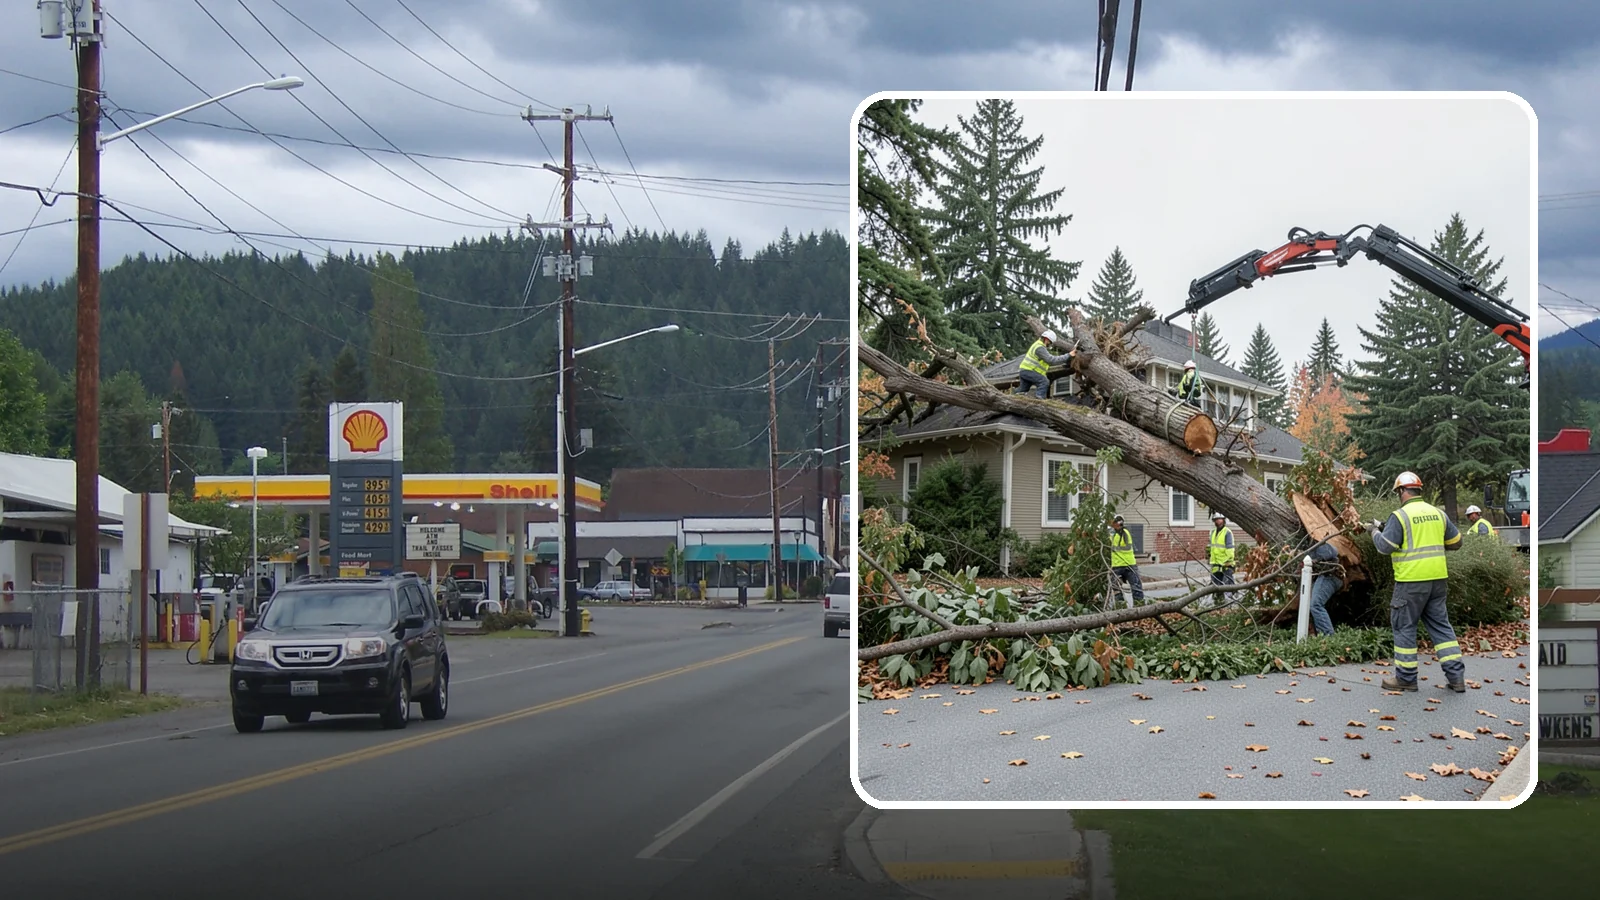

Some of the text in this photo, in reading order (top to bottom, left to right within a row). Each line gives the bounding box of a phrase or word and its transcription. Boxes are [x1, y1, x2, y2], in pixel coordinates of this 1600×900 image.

[366, 480, 383, 490] 395
[490, 484, 547, 499] Shell
[366, 494, 383, 504] 405
[366, 508, 383, 518] 415
[366, 522, 383, 532] 429
